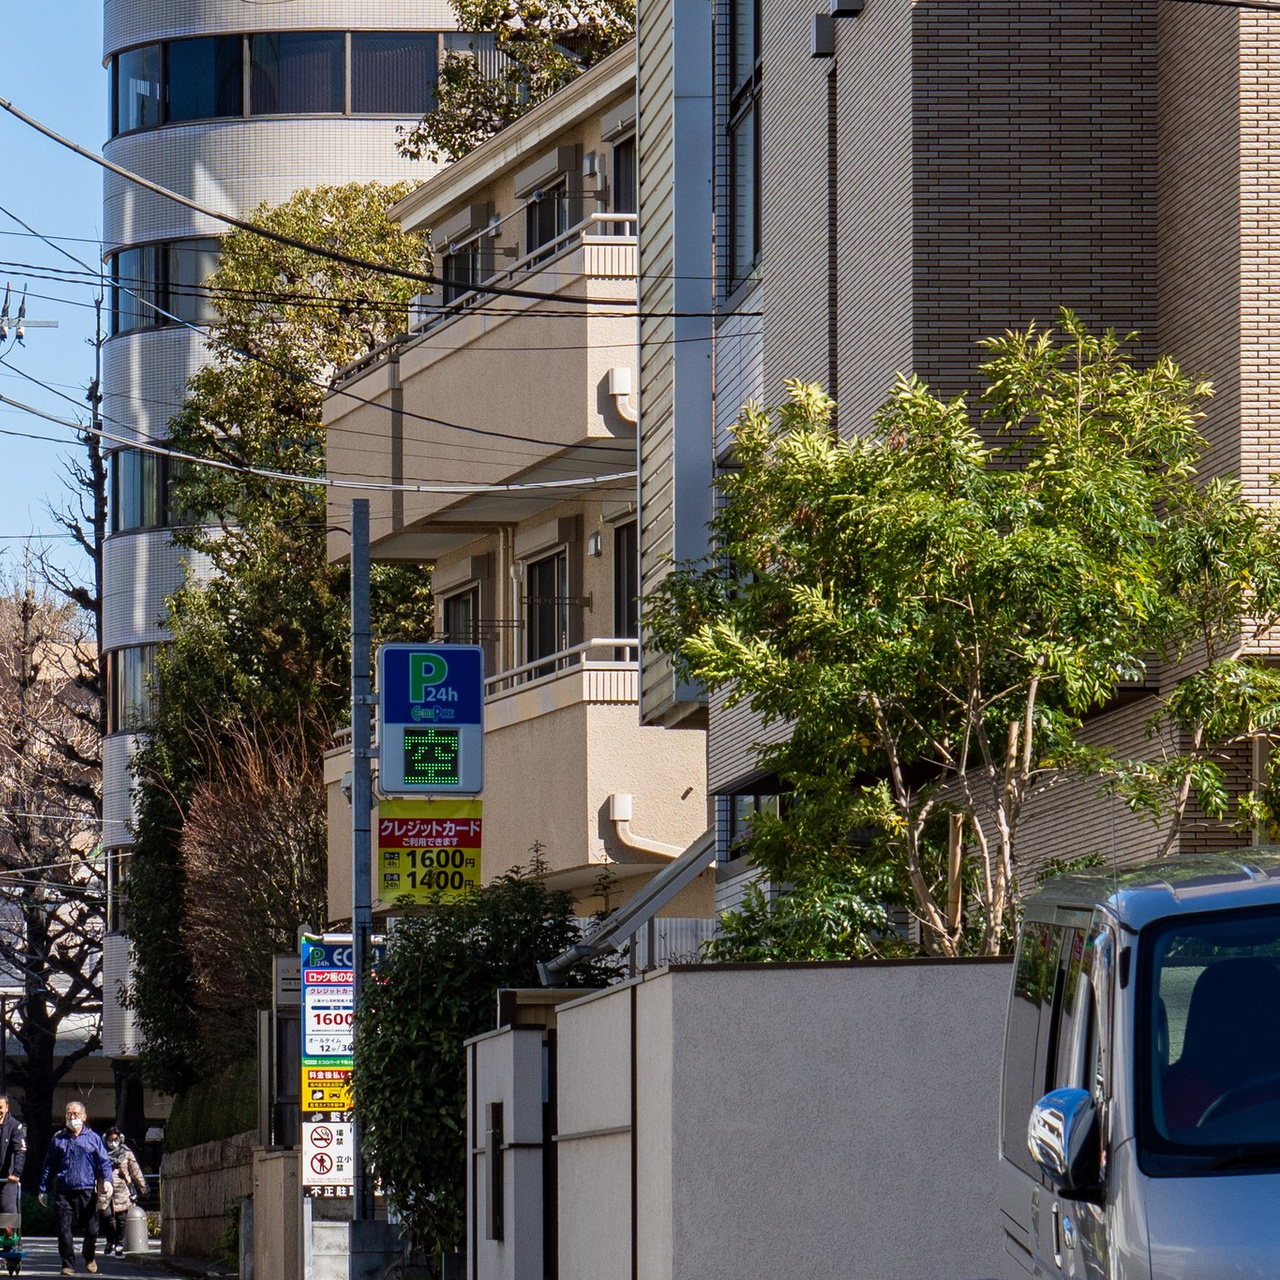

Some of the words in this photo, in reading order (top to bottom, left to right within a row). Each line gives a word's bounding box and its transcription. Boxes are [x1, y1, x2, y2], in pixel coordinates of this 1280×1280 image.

[409, 652, 449, 703] P
[426, 687, 458, 702] 24h
[404, 728, 459, 784] 空
[381, 820, 480, 837] クレジットカード
[402, 837, 459, 847] ご利用できます
[309, 947, 326, 967] P
